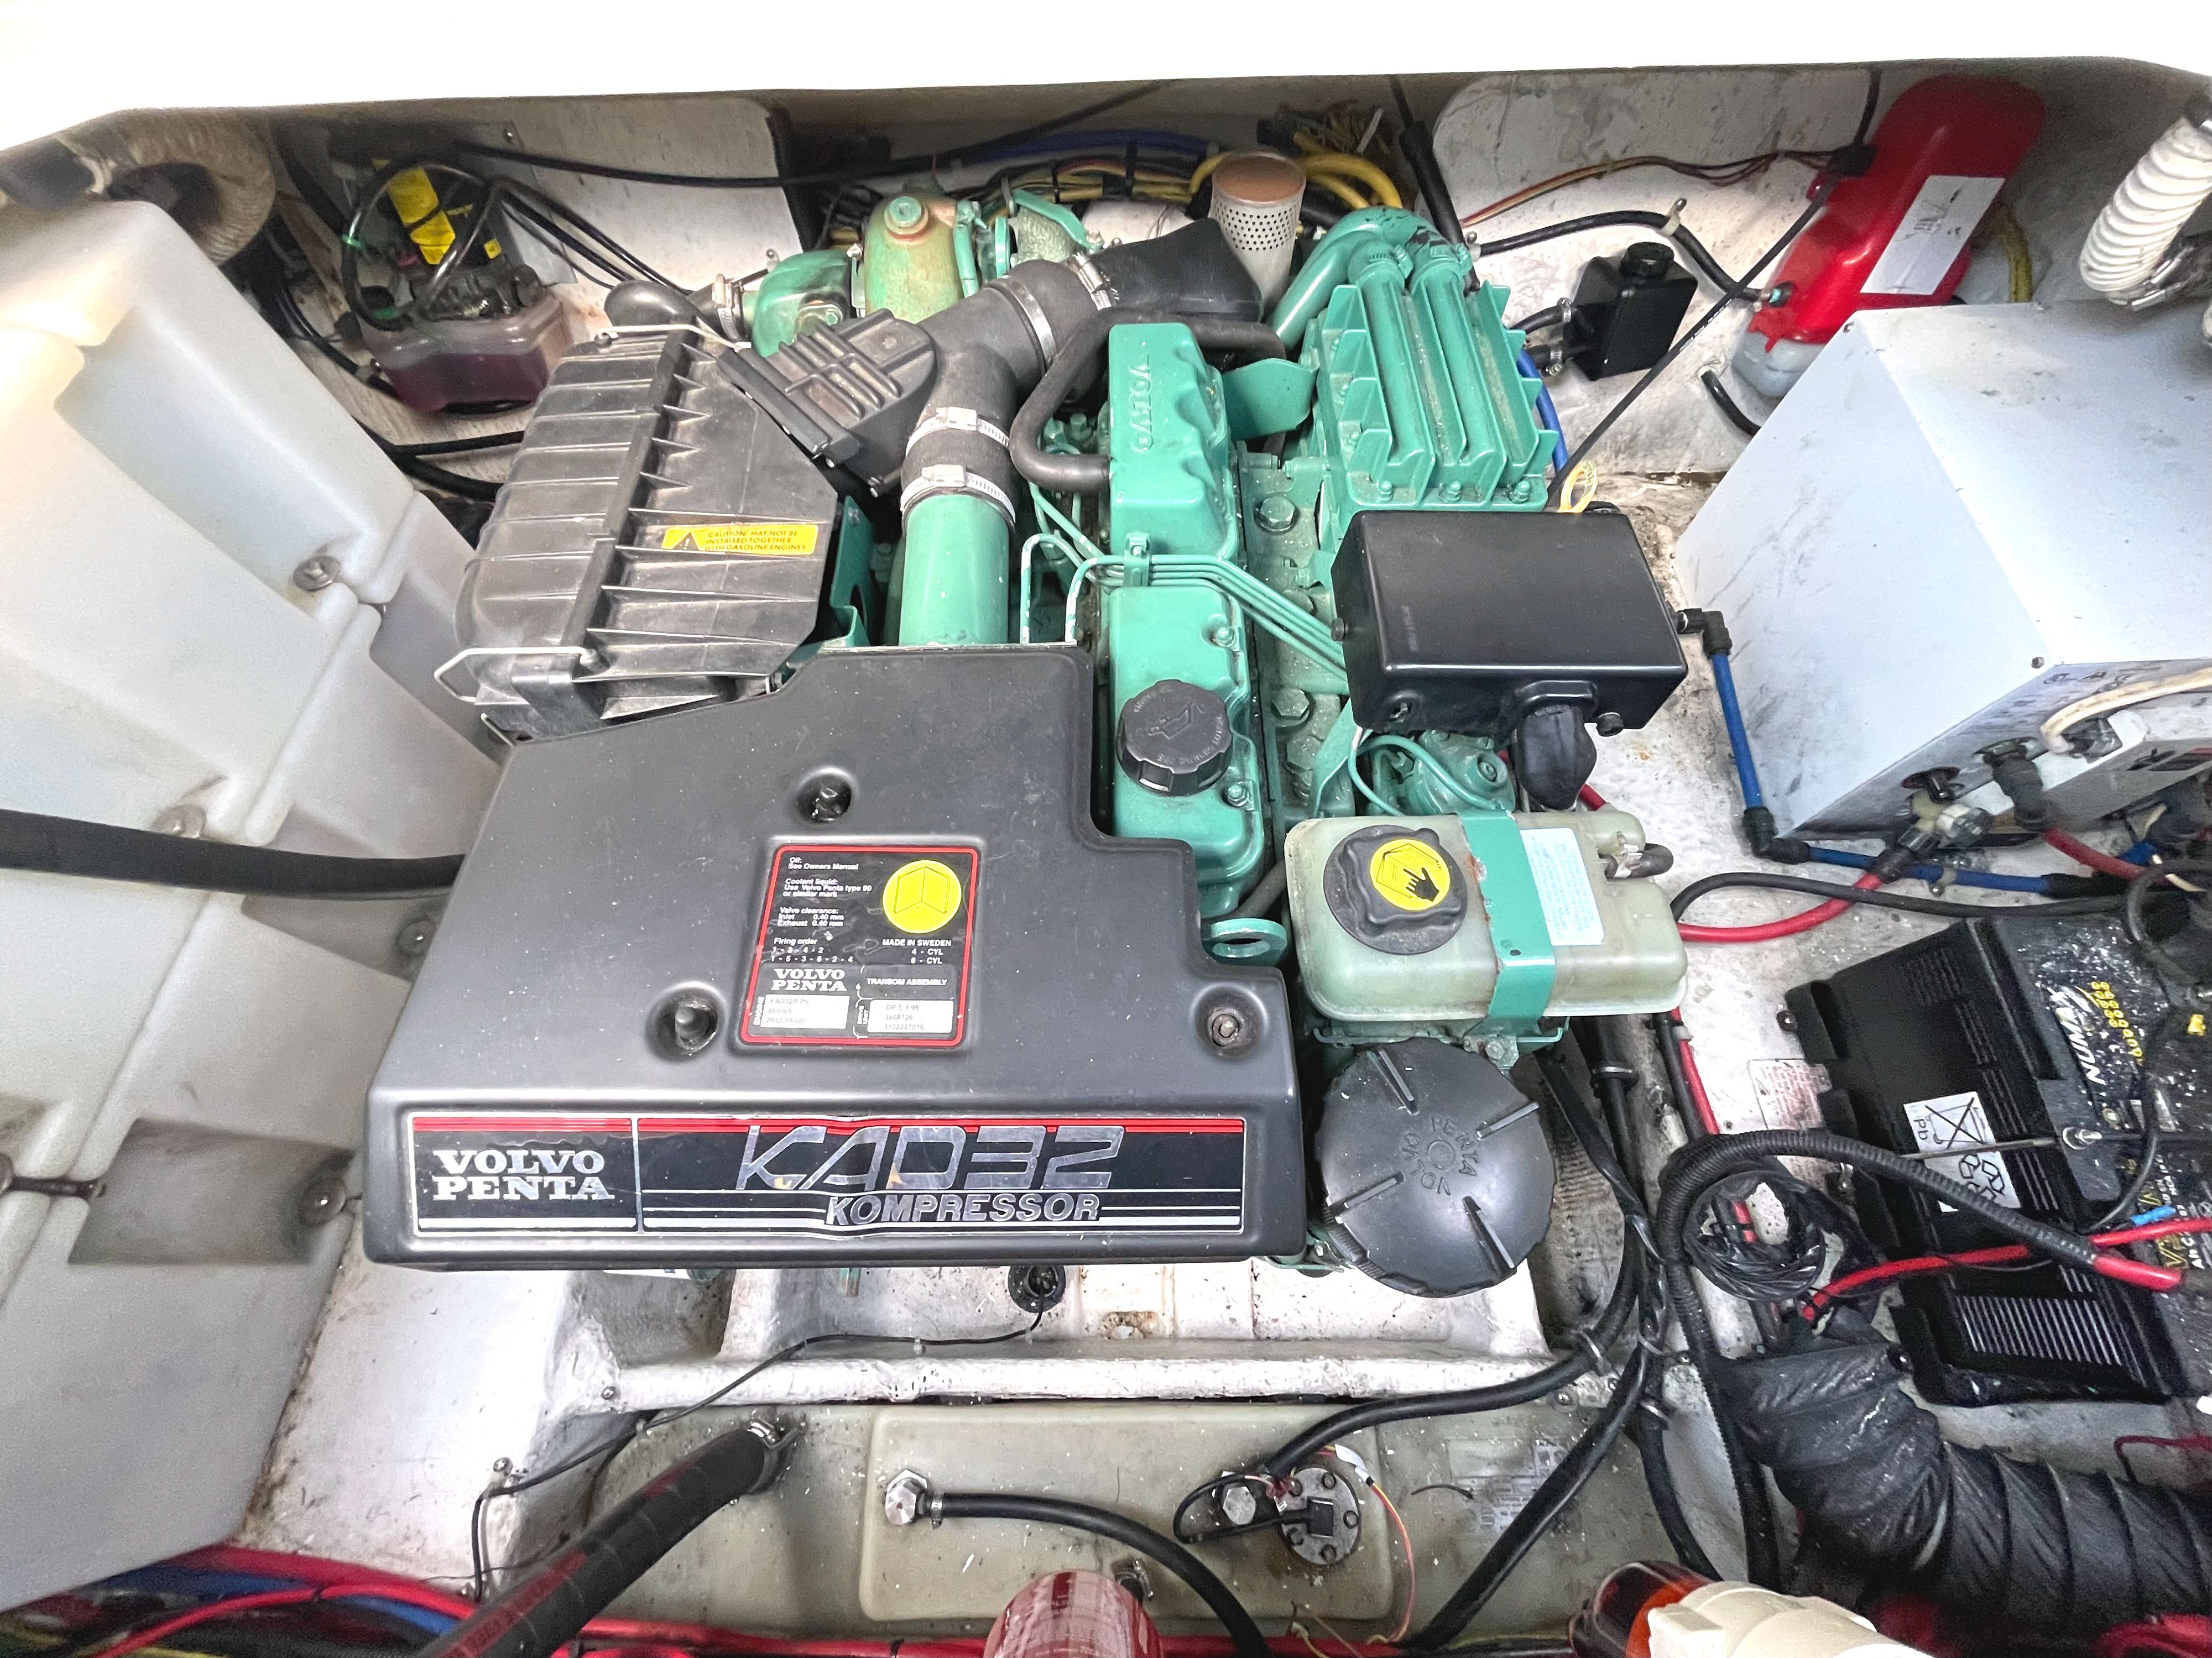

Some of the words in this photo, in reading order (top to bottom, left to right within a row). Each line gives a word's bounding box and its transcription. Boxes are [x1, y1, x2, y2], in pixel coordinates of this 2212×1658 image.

[1128, 354, 1153, 453] VOLVO
[771, 980, 847, 991] PENTA
[774, 968, 846, 980] VOLVO
[433, 1149, 605, 1174] VOLVO
[735, 1125, 1125, 1190] KAD32
[1431, 1116, 1479, 1176] PENTA
[1402, 1132, 1451, 1196] VOLVO
[432, 1176, 615, 1200] PENTA
[826, 1192, 1103, 1226] KOMPRESSOR
